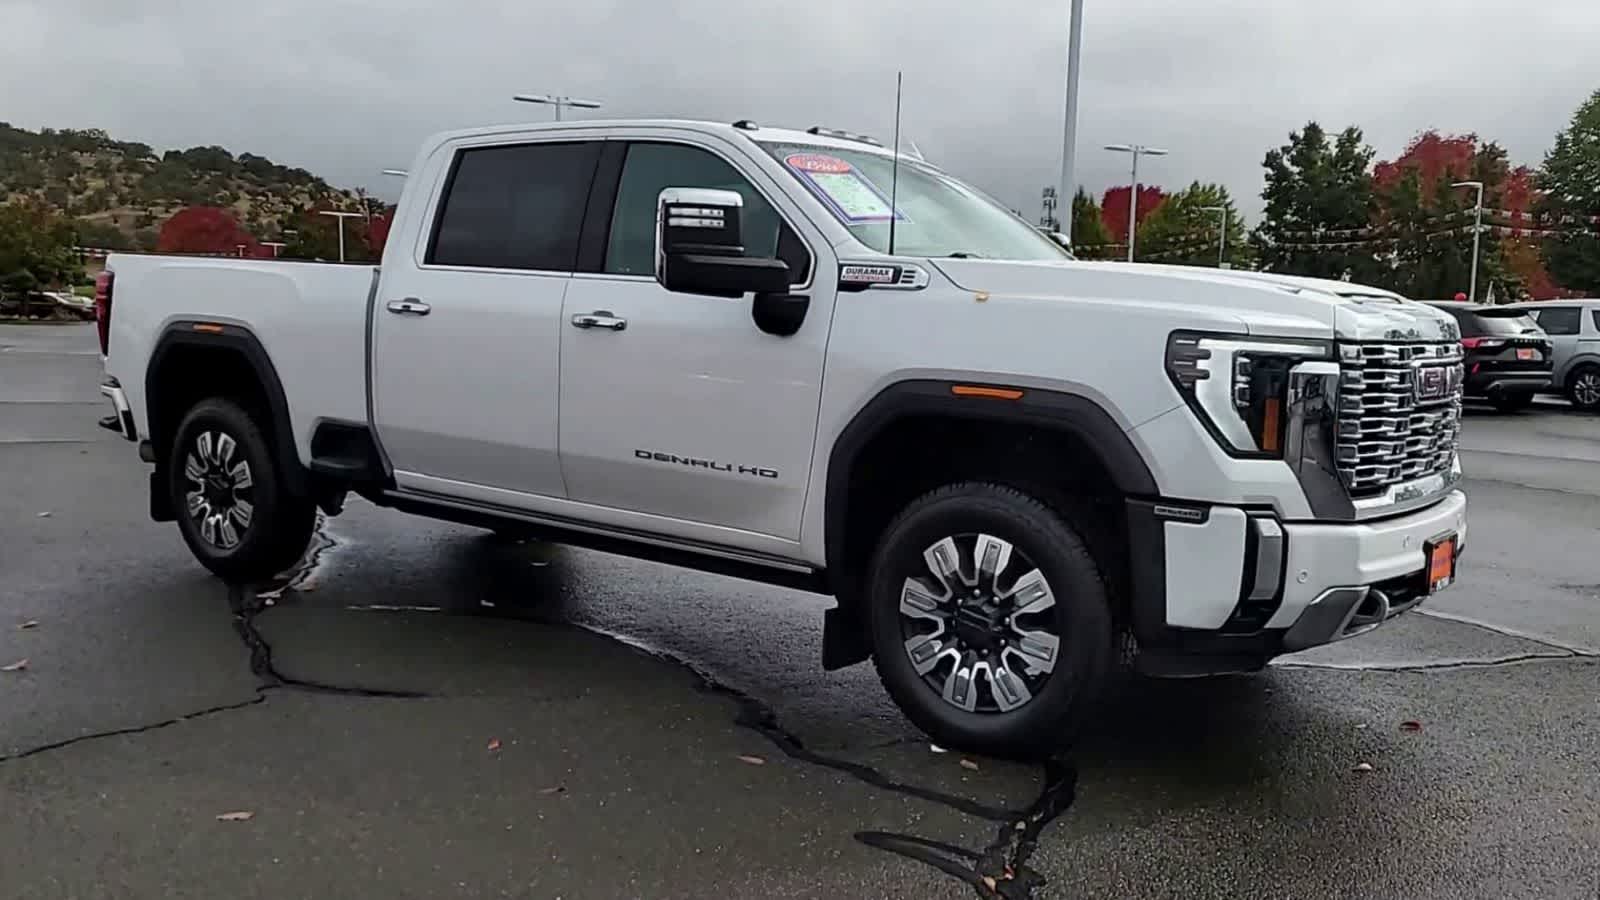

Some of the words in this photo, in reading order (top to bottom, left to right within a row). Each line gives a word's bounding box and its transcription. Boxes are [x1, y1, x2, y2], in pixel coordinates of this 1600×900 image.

[845, 267, 890, 276] DURAMAX
[634, 449, 732, 472] DENALI
[738, 465, 778, 478] HD
